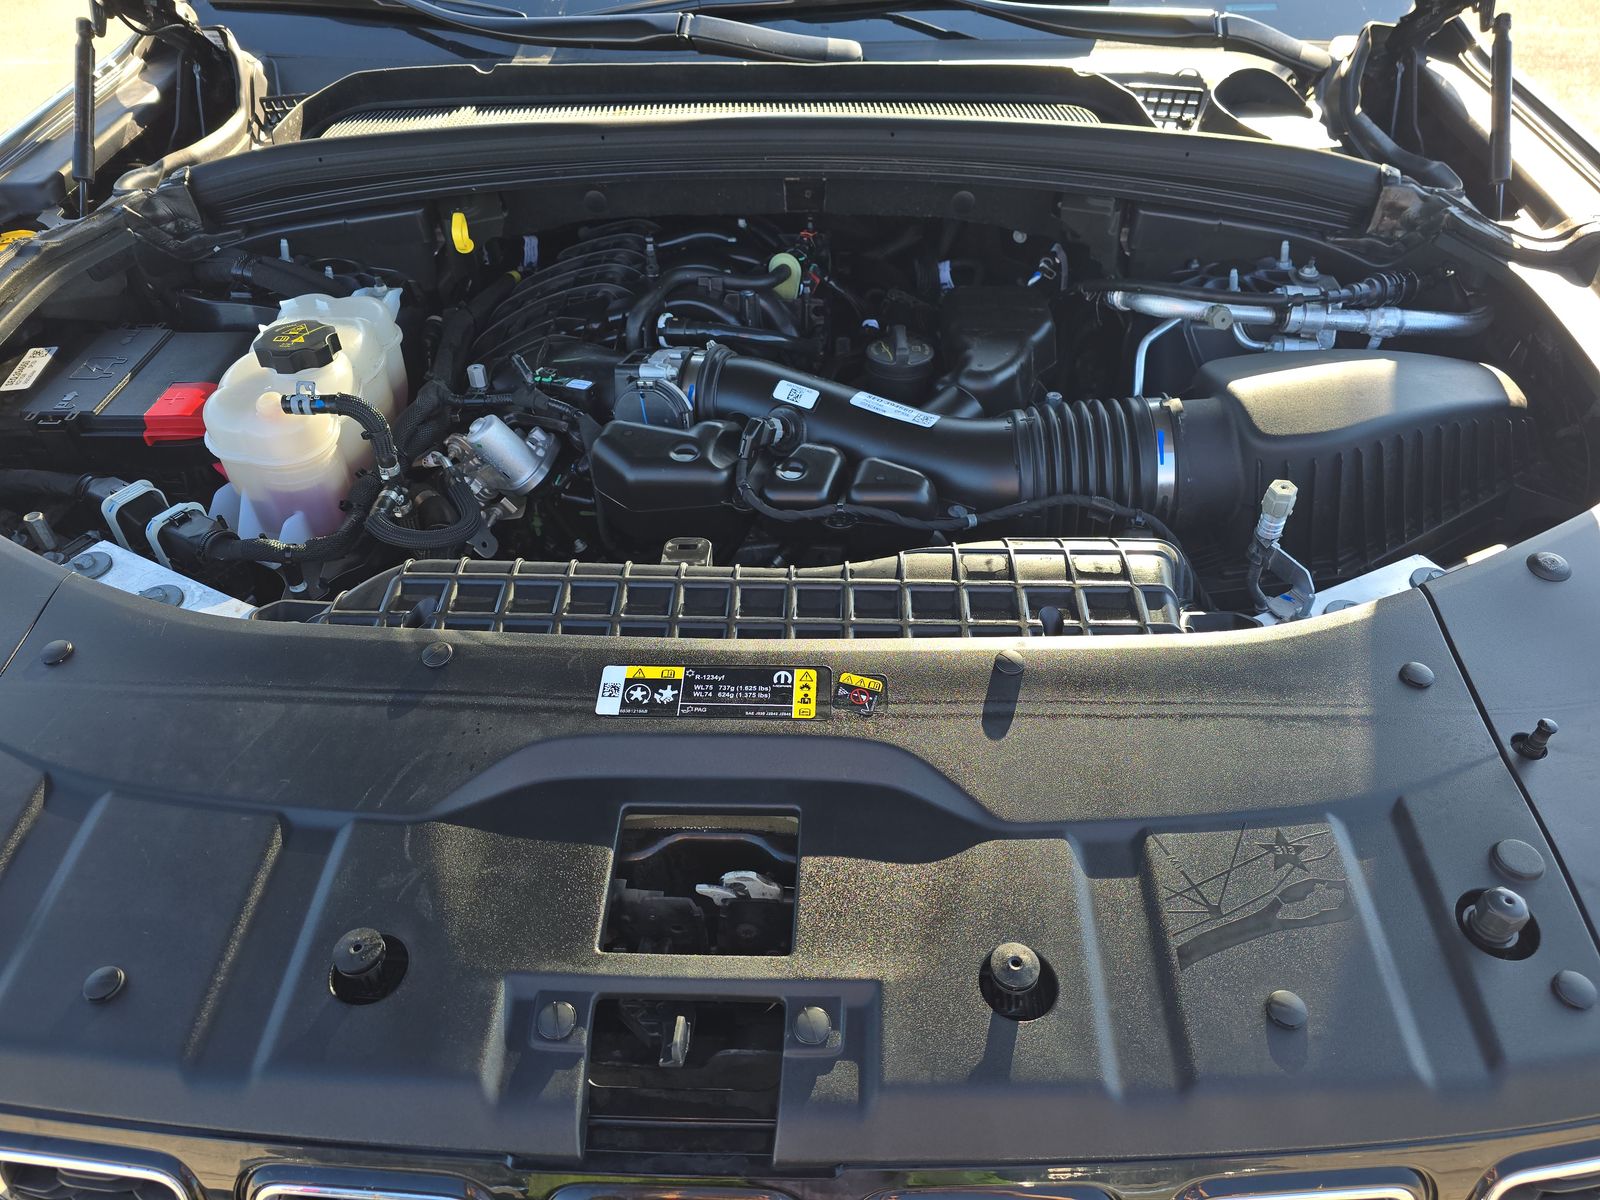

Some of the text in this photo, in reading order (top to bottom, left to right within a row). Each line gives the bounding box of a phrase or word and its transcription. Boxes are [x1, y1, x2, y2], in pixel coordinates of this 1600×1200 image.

[694, 674, 725, 682] R-1234yf
[718, 684, 735, 692] 737g
[717, 691, 734, 699] 624g
